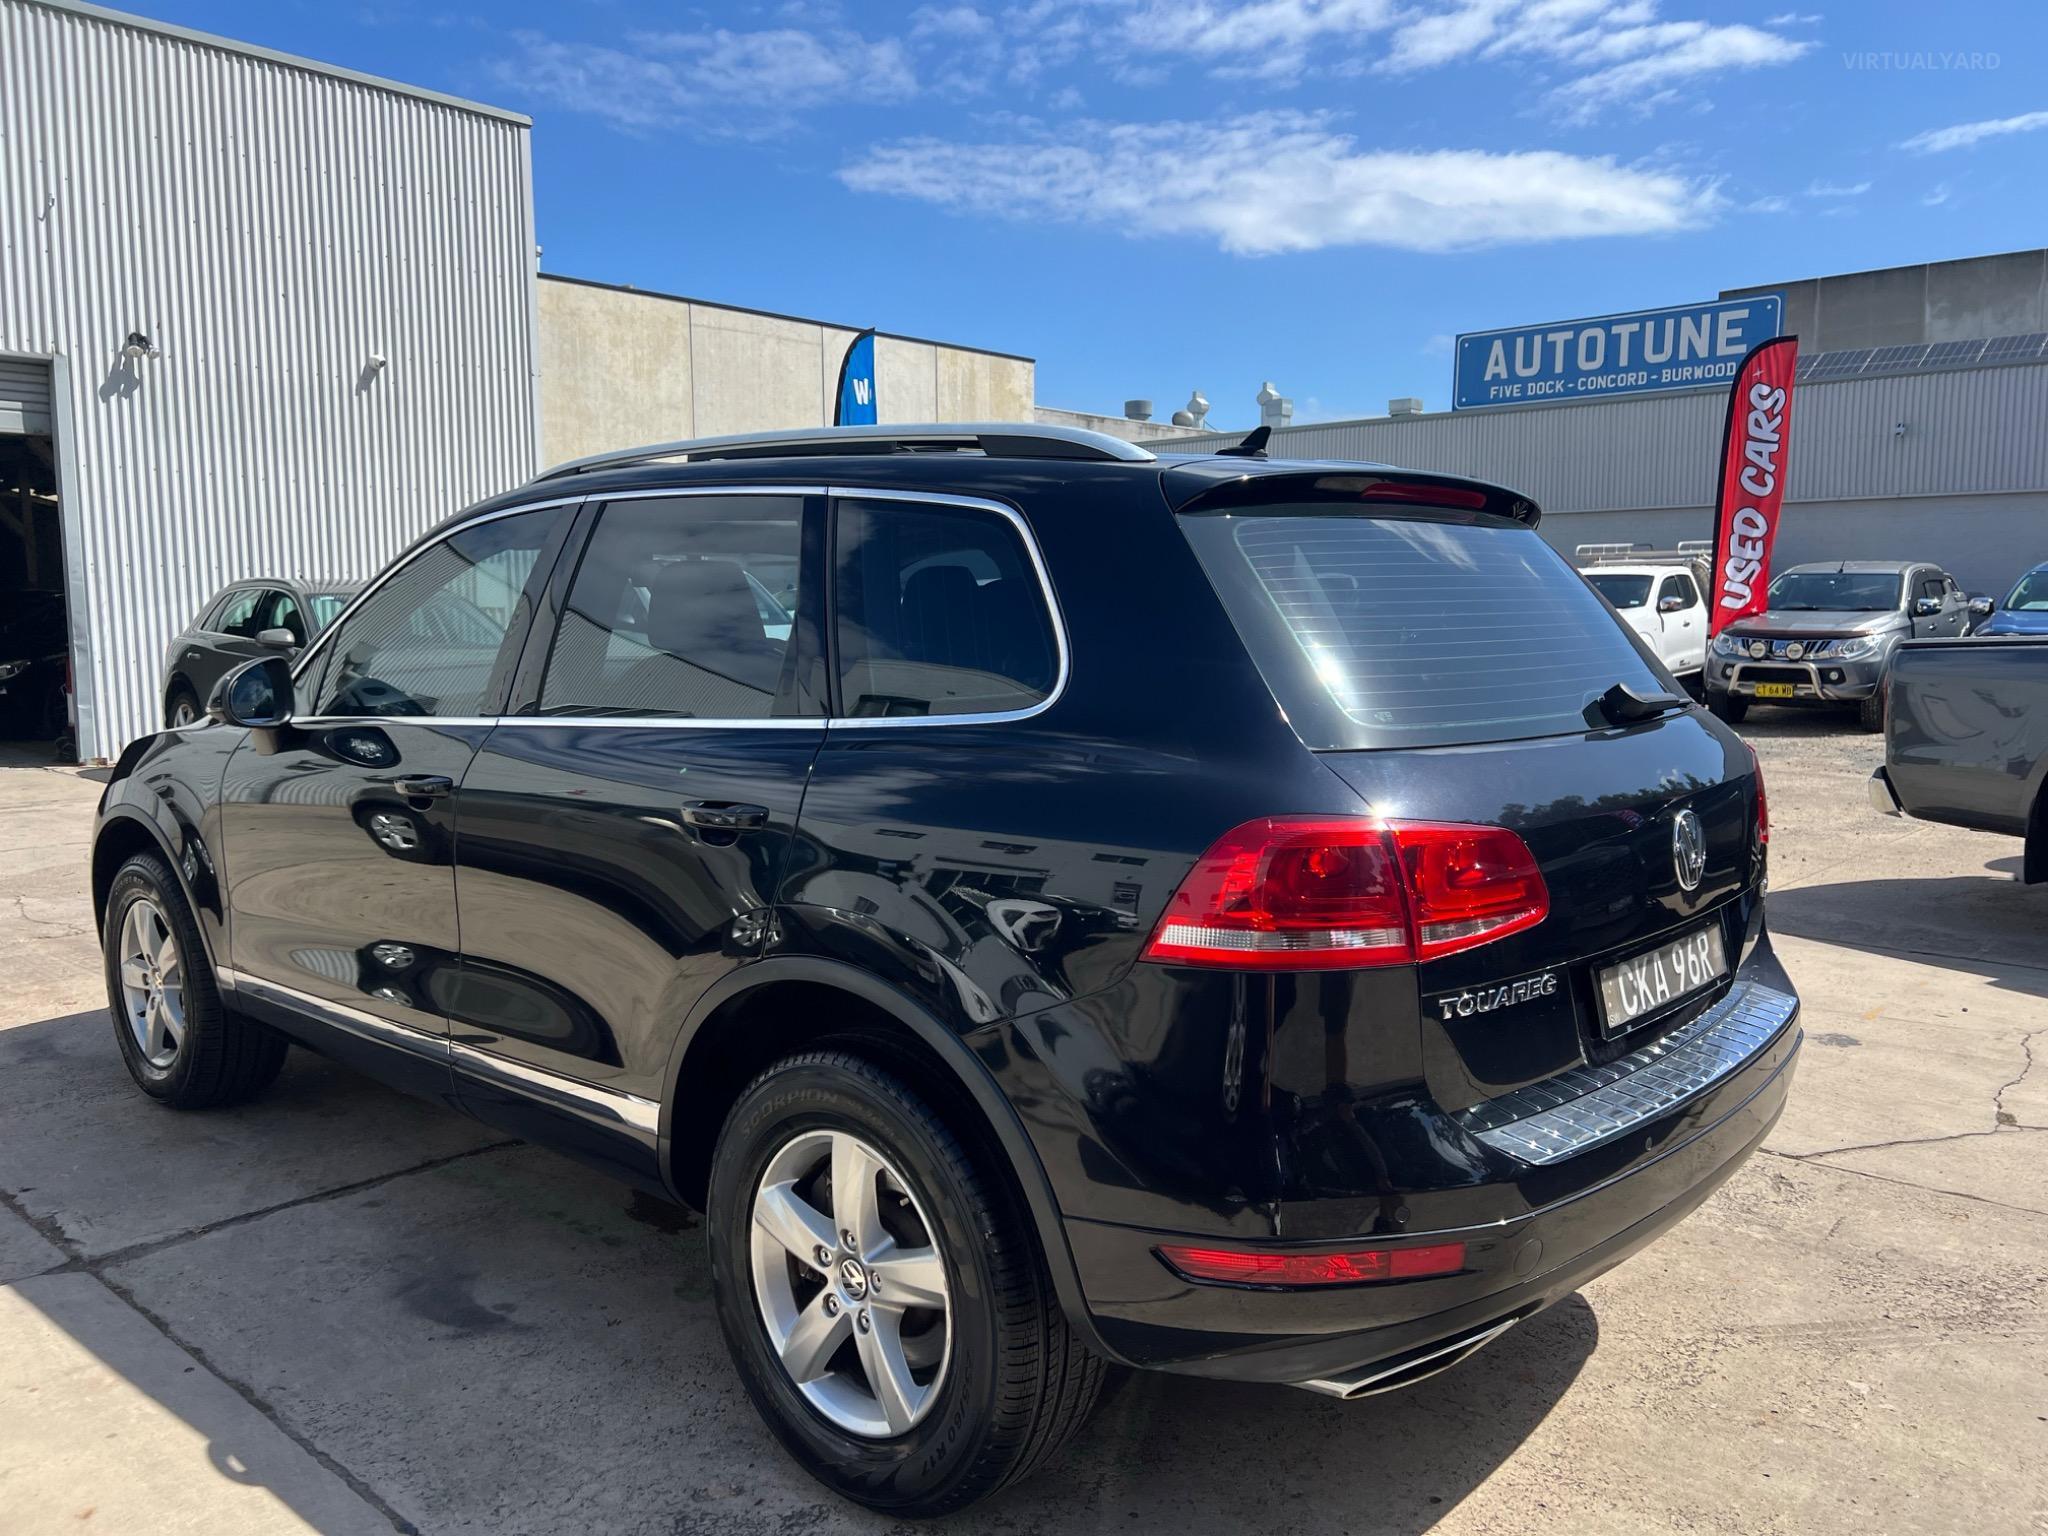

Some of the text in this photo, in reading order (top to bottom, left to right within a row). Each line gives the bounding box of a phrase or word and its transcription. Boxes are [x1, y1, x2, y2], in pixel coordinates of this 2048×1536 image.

[1484, 308, 1750, 381] AUTOTUNE
[1490, 384, 1521, 399] FIVE
[1721, 382, 1786, 610] USED CARS
[1439, 974, 1557, 1019] TOUAREG
[1618, 931, 1715, 1016] CKA 96R
